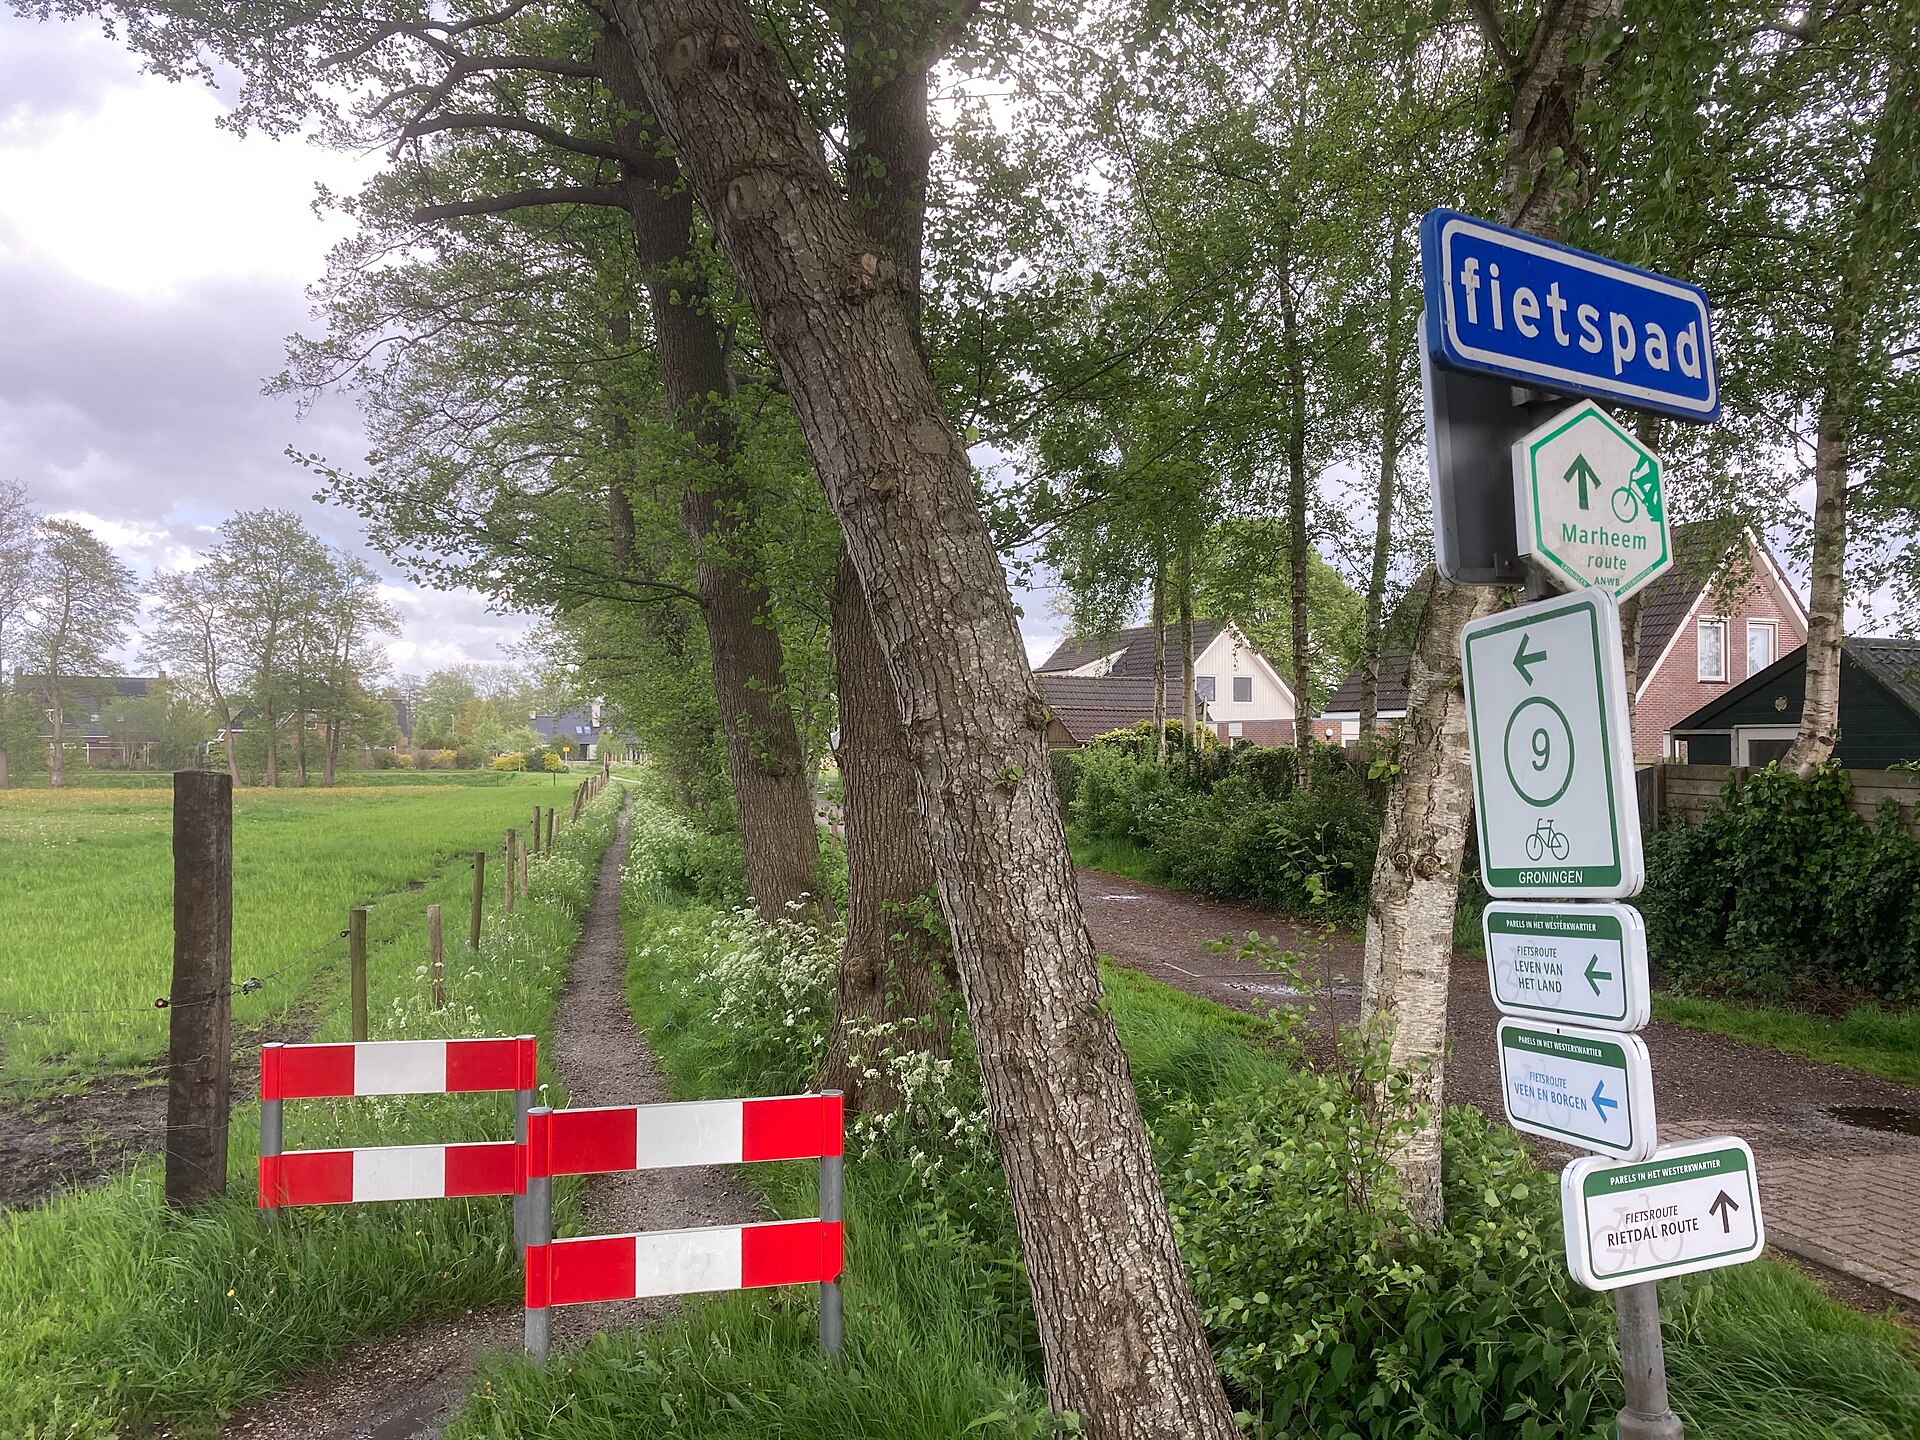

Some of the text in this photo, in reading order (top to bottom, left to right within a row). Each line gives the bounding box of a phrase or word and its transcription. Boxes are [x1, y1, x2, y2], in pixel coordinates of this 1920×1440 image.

[1461, 257, 1702, 379] fietspad
[1562, 523, 1647, 549] Marheem
[1587, 555, 1627, 570] route
[1560, 563, 1588, 587] GRONINGEN
[1594, 576, 1621, 587] ANWB
[1531, 727, 1551, 771] 9
[1518, 871, 1583, 884] GRONINGEN
[1506, 919, 1597, 932] PARELS IN HET WESTERKWARTIER
[1517, 946, 1557, 958] FIETSROUTE
[1514, 960, 1563, 976] LEVEN VAN
[1518, 977, 1562, 993] HET LAND
[1518, 1036, 1602, 1057] PARELS IN HET WESTERKWARTIER
[1529, 1071, 1567, 1089] FIETSROUTE
[1514, 1082, 1588, 1111] VEEN EN BORGEN
[1610, 1159, 1721, 1186] PARELS IN HET WESTERKWARTIER
[1625, 1205, 1678, 1225] FIETSROUTE
[1607, 1218, 1700, 1247] RIETDAL ROUTE
